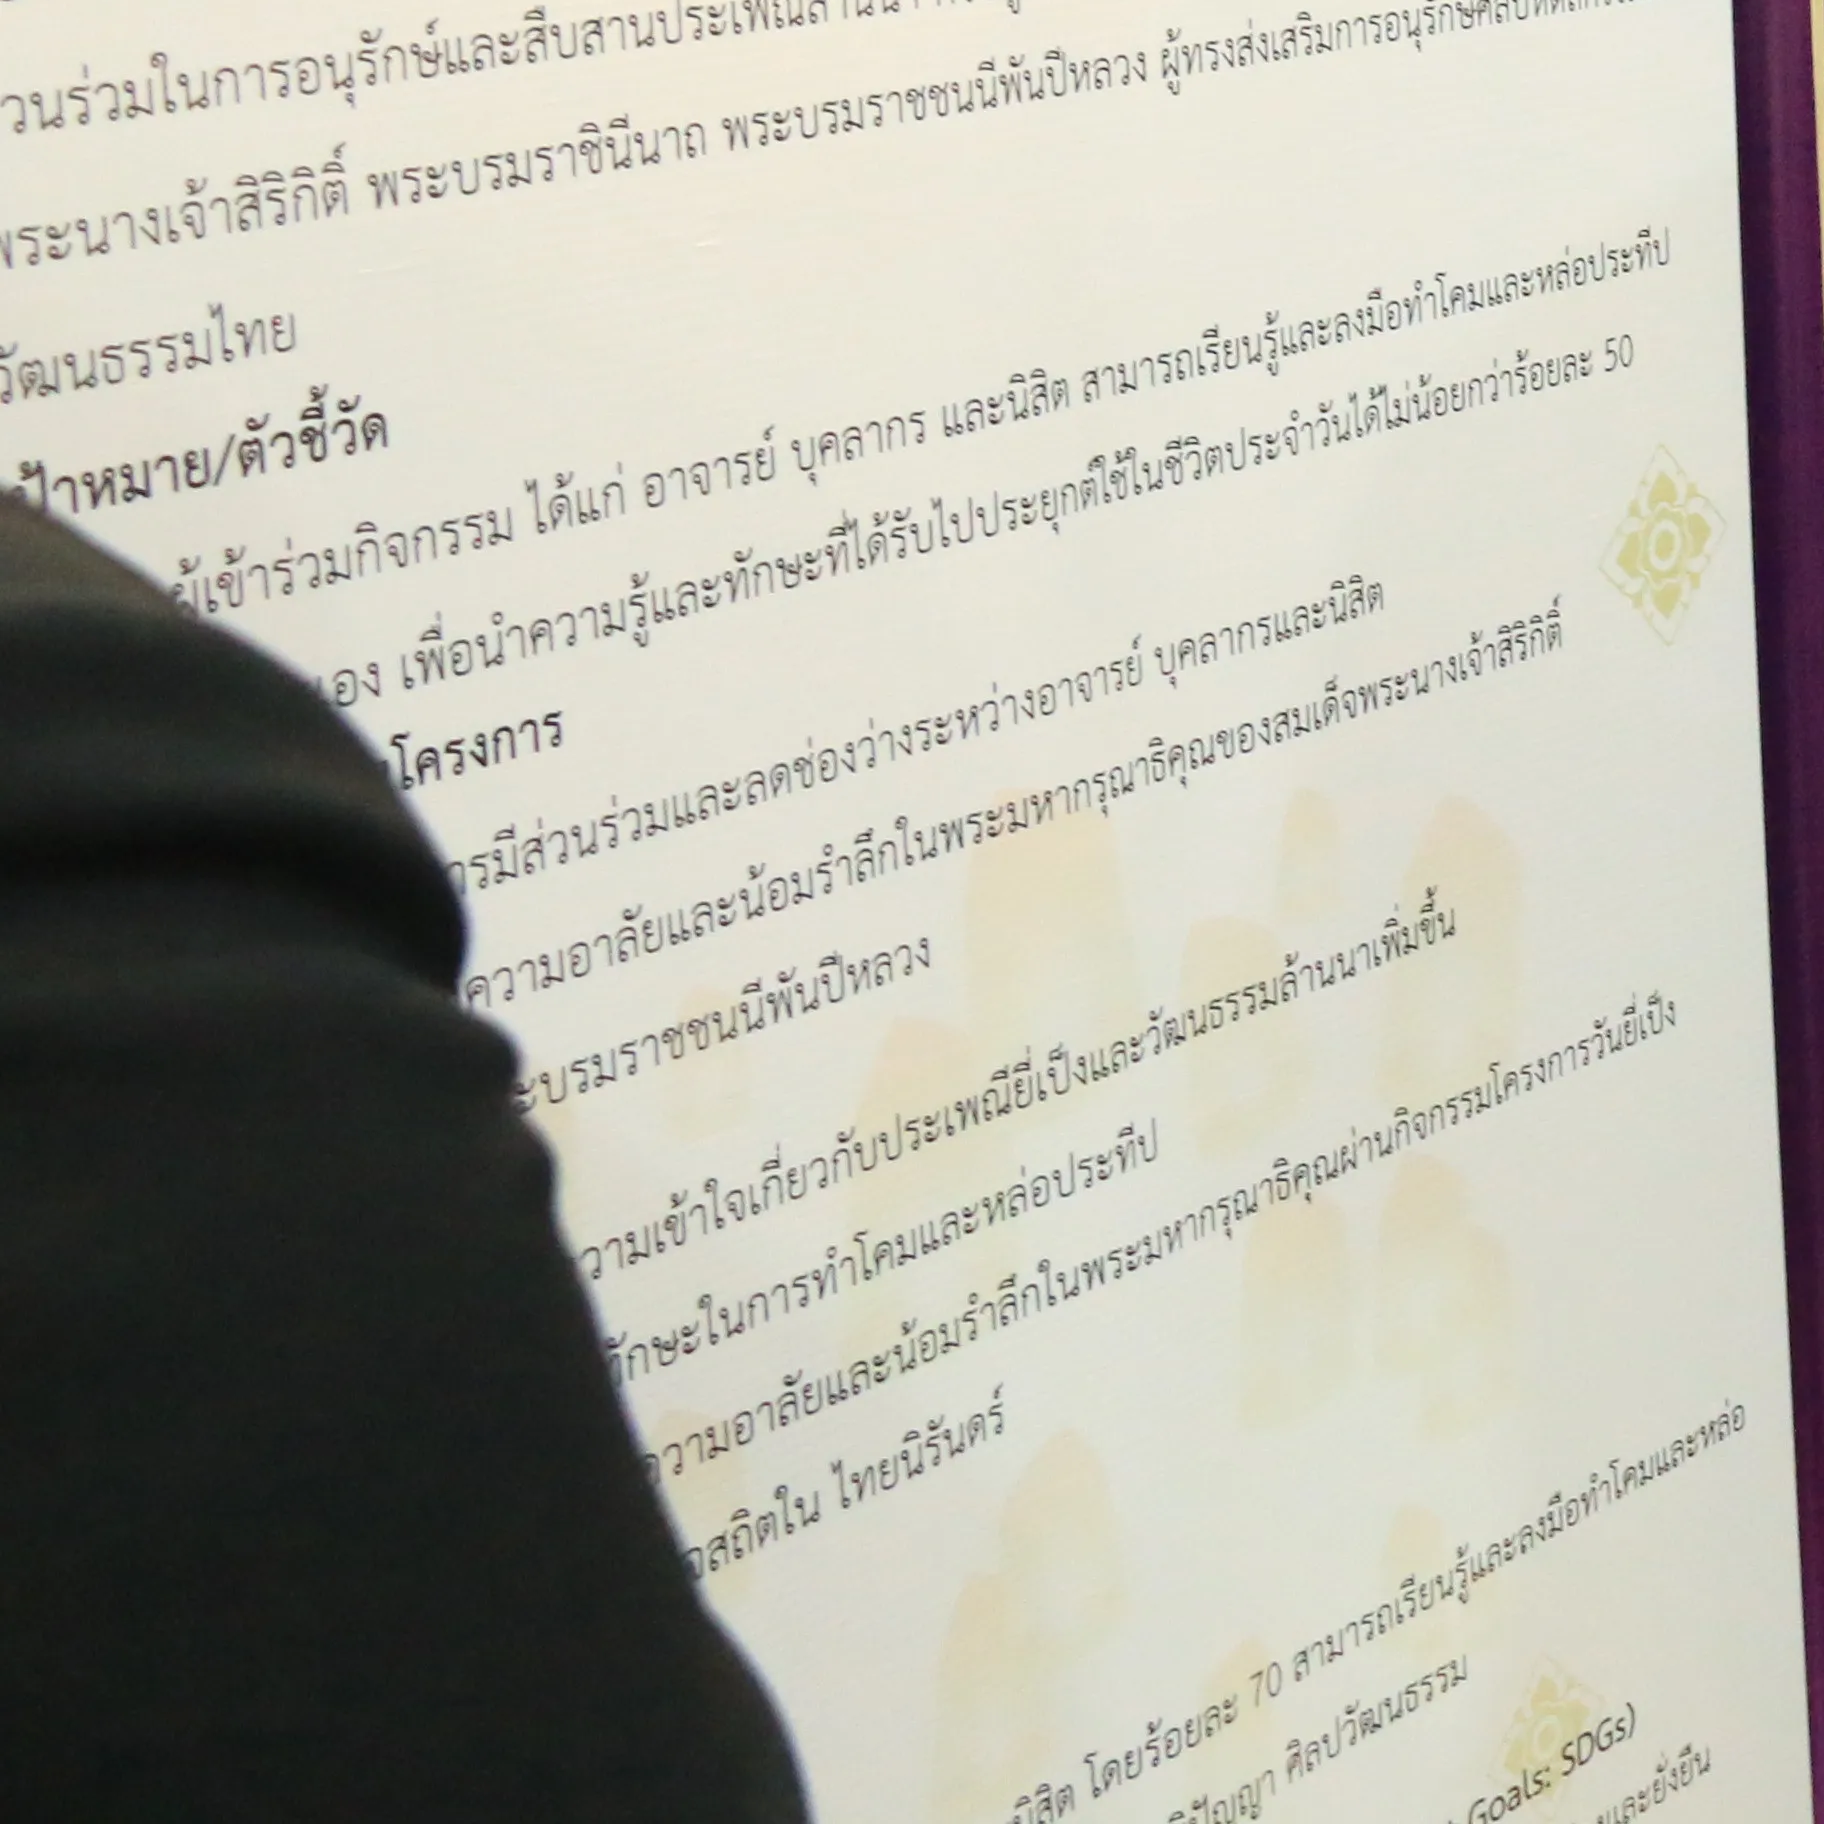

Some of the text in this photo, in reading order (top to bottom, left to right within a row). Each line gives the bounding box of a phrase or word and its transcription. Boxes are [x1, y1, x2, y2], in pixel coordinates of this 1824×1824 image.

[367, 114, 707, 210] พระบรมราชินีนาถ
[722, 43, 1148, 152] พระบรมราชชนนีพันปีหลวง
[1604, 333, 1635, 374] 50
[524, 461, 626, 536] ได้แก่
[643, 424, 777, 508] อาจารย์
[791, 409, 929, 487] บุคลากร
[942, 368, 1071, 439] และนิสิต
[1153, 574, 1385, 688] บุคลากรและนิสิต
[829, 1383, 1006, 1510] ไทยนิรันดร์
[1083, 1694, 1239, 1800] โดยร้อยละ
[1249, 1661, 1283, 1708] 70
[1285, 1654, 1470, 1784] ศิลปวัฒนธรรม
[1561, 1701, 1637, 1778] SDGs)
